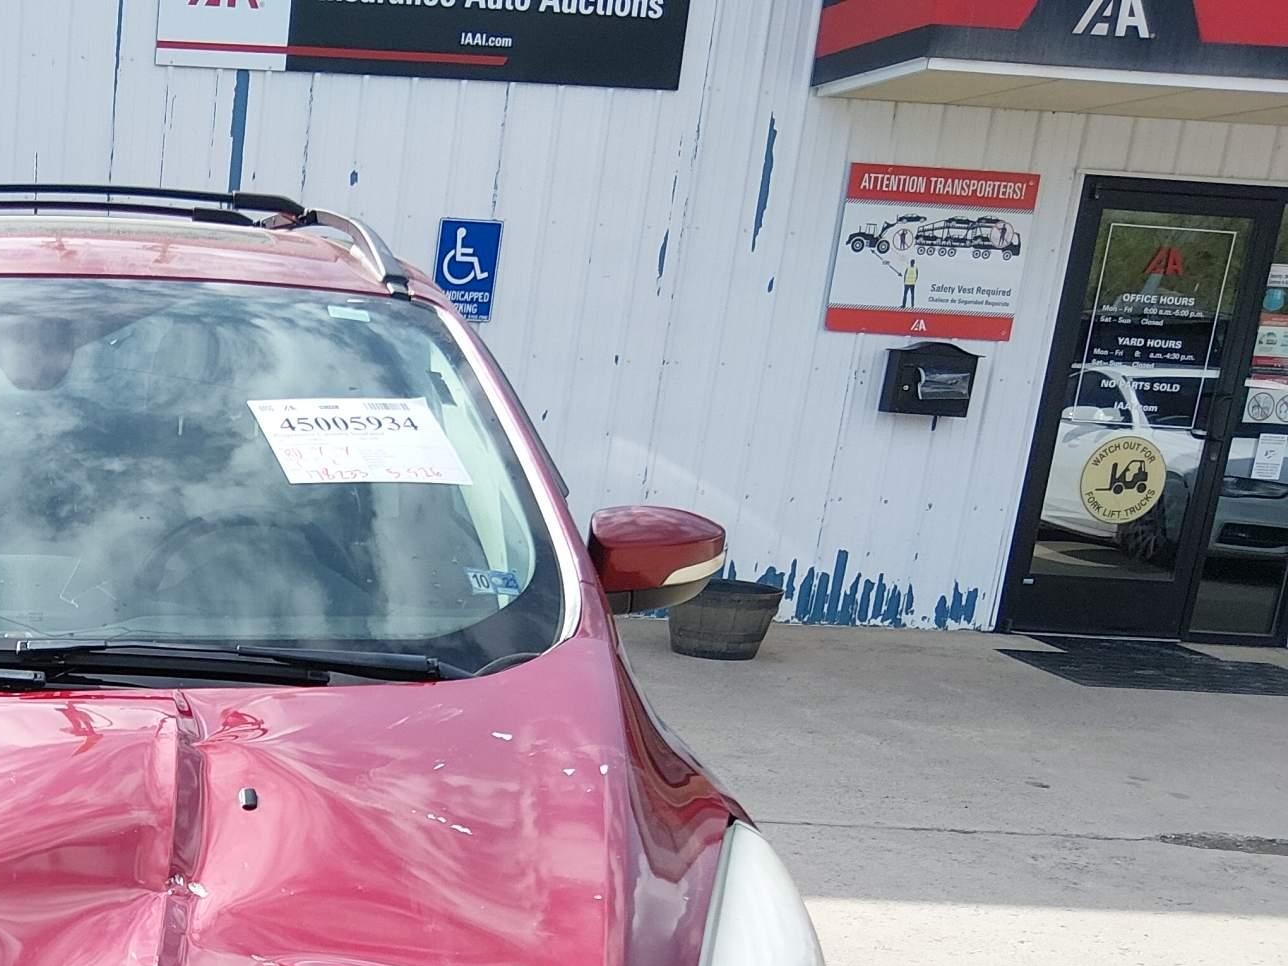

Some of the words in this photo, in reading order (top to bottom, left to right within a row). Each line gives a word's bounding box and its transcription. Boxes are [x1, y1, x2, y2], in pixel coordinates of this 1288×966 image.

[538, 0, 664, 19] Auctions
[460, 32, 512, 47] IAAI.com
[860, 173, 926, 193] ATTENTION
[929, 177, 1027, 200] TRANSPORTERS!
[442, 290, 489, 302] NDICAPPED
[930, 284, 956, 295] Safety
[957, 286, 974, 294] Vest
[975, 287, 1012, 298] Required
[1122, 293, 1158, 304] OFFICE
[1159, 295, 1196, 306] HOURS
[455, 303, 478, 314] RKING
[1102, 304, 1118, 312] Mon
[1100, 315, 1112, 323] Sat
[1117, 337, 1145, 347] YARD
[1146, 339, 1183, 349] HOURS
[1100, 379, 1116, 389] NO
[1152, 382, 1181, 393] SOLD
[279, 415, 418, 432] 45005934
[1092, 443, 1121, 467] WATCH
[1122, 441, 1143, 451] OUT
[1140, 446, 1156, 464] FOR
[1085, 491, 1104, 513] FORK
[1102, 507, 1122, 518] LIFT
[1123, 489, 1156, 516] TRUCKS
[472, 574, 490, 589] 10
